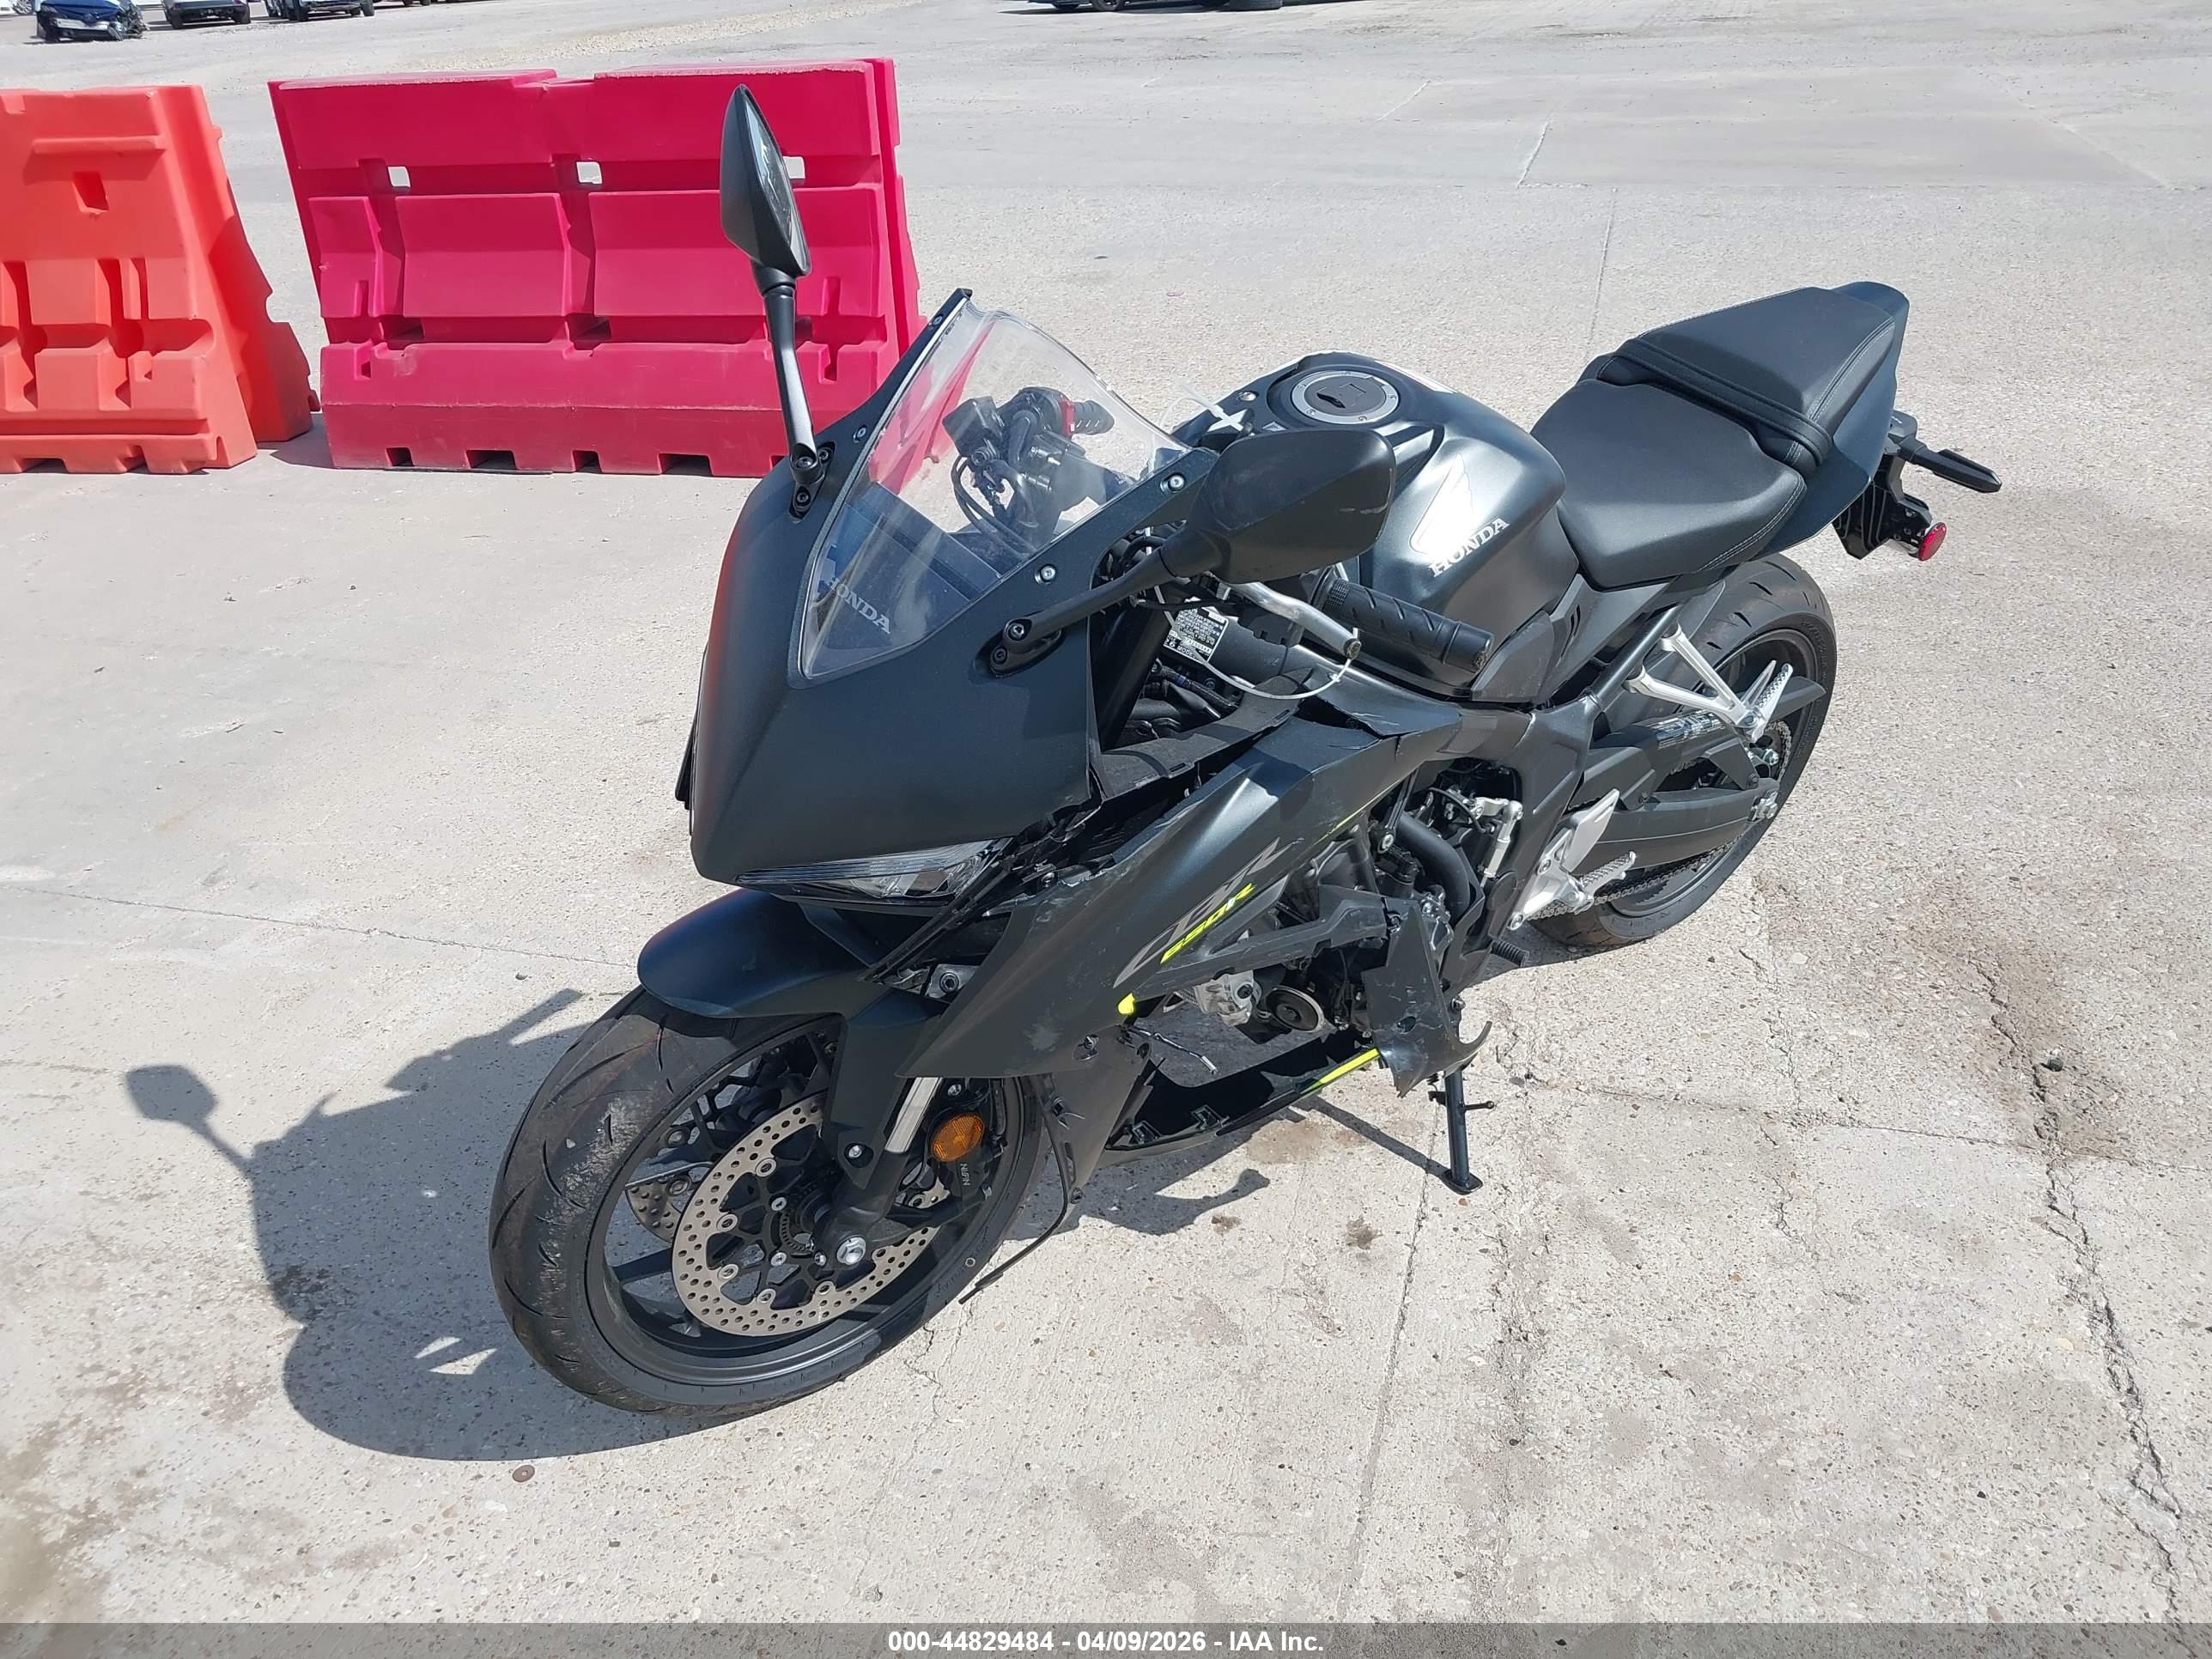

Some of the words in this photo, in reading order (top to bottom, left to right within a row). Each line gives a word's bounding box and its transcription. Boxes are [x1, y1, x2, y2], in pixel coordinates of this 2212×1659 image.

[1428, 517, 1510, 578] HONDA
[827, 577, 891, 635] HONDA
[1113, 837, 1302, 988] CBR
[1160, 883, 1255, 963] 650R
